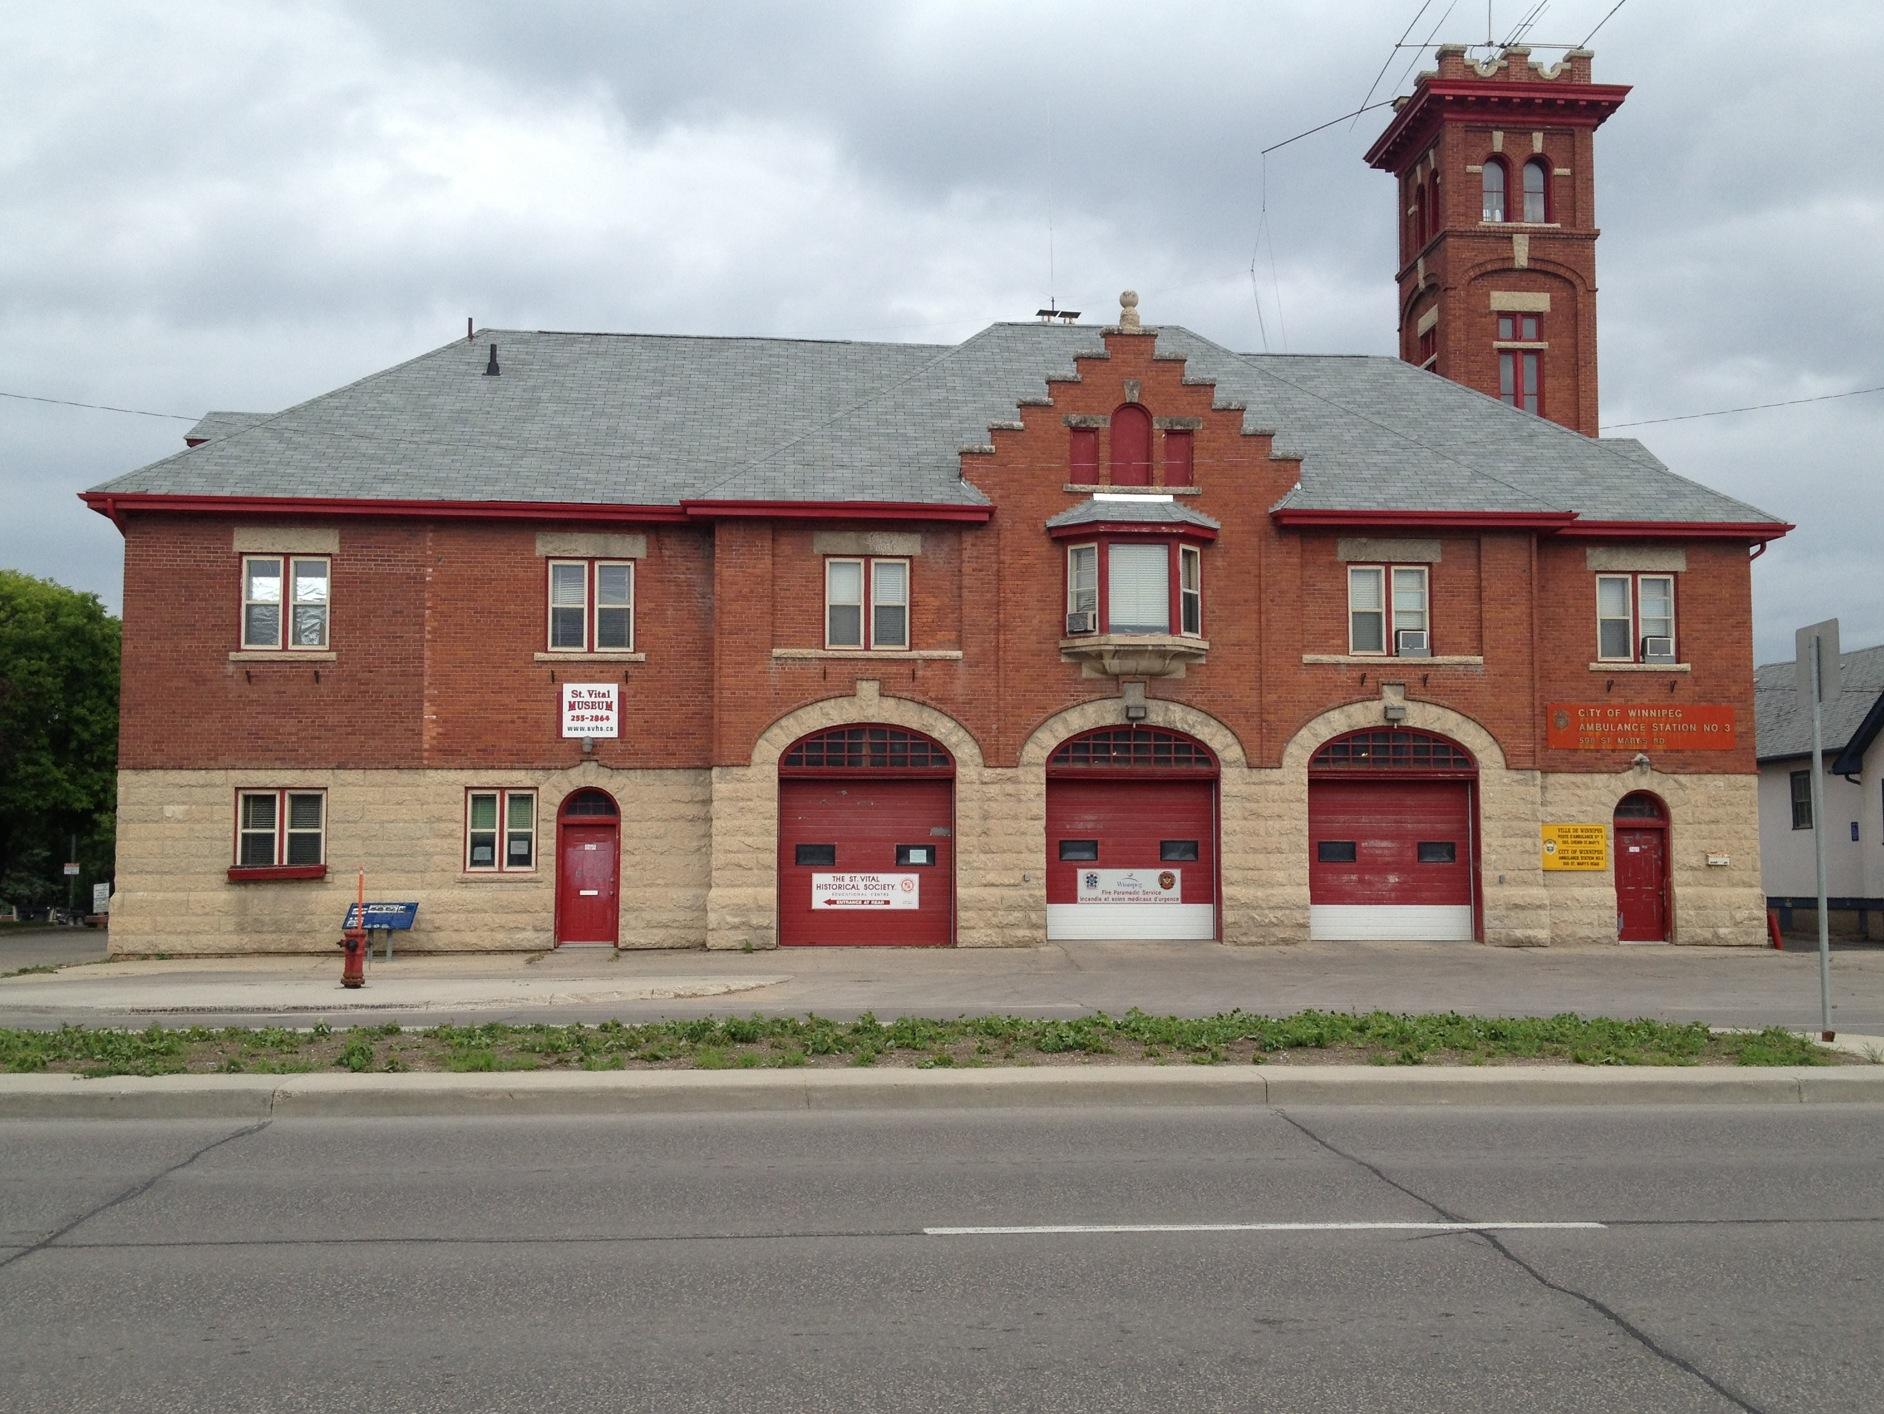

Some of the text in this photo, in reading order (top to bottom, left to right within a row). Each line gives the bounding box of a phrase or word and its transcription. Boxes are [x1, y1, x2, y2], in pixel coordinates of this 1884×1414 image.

[571, 689, 611, 699] St. Vital
[567, 700, 614, 712] MUSEUM
[1578, 708, 1683, 718] CITY OF WINNIPEG
[570, 714, 610, 722] 255-2864
[1579, 723, 1646, 732] AMBULANCE
[1652, 723, 1697, 732] STATION
[1724, 723, 1731, 732] 3
[832, 875, 880, 883] THE ST. VITAL
[816, 883, 860, 891] HISTORICAL
[864, 883, 896, 891] SOCIETY
